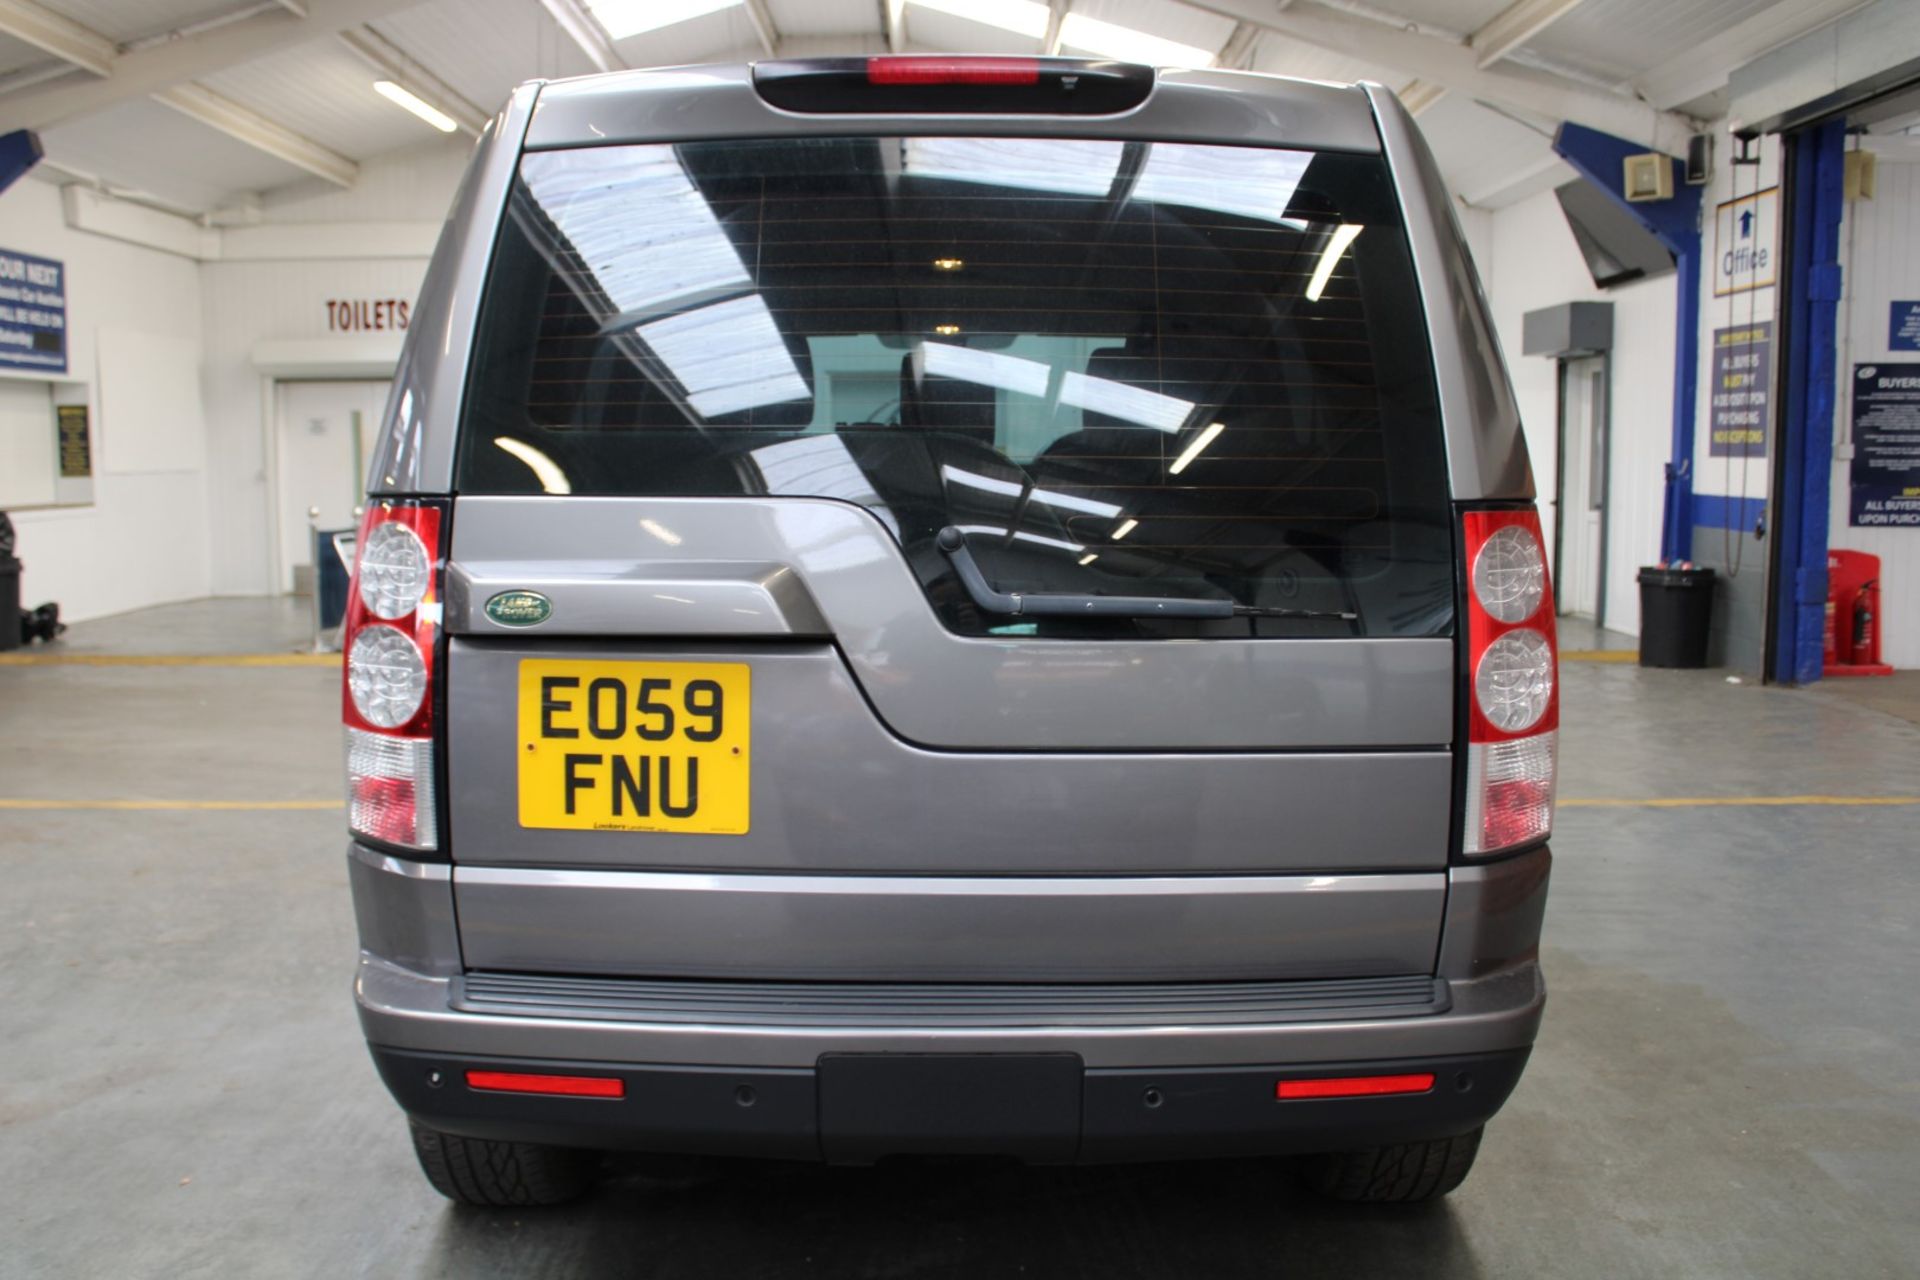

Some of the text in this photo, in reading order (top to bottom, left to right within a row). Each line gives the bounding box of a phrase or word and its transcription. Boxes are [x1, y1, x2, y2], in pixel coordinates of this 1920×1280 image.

[1723, 247, 1768, 276] Office
[326, 300, 409, 330] TOILETS
[1858, 514, 1888, 524] UPON
[1865, 501, 1883, 511] ALL
[541, 676, 723, 742] EO59
[564, 754, 698, 818] FNU
